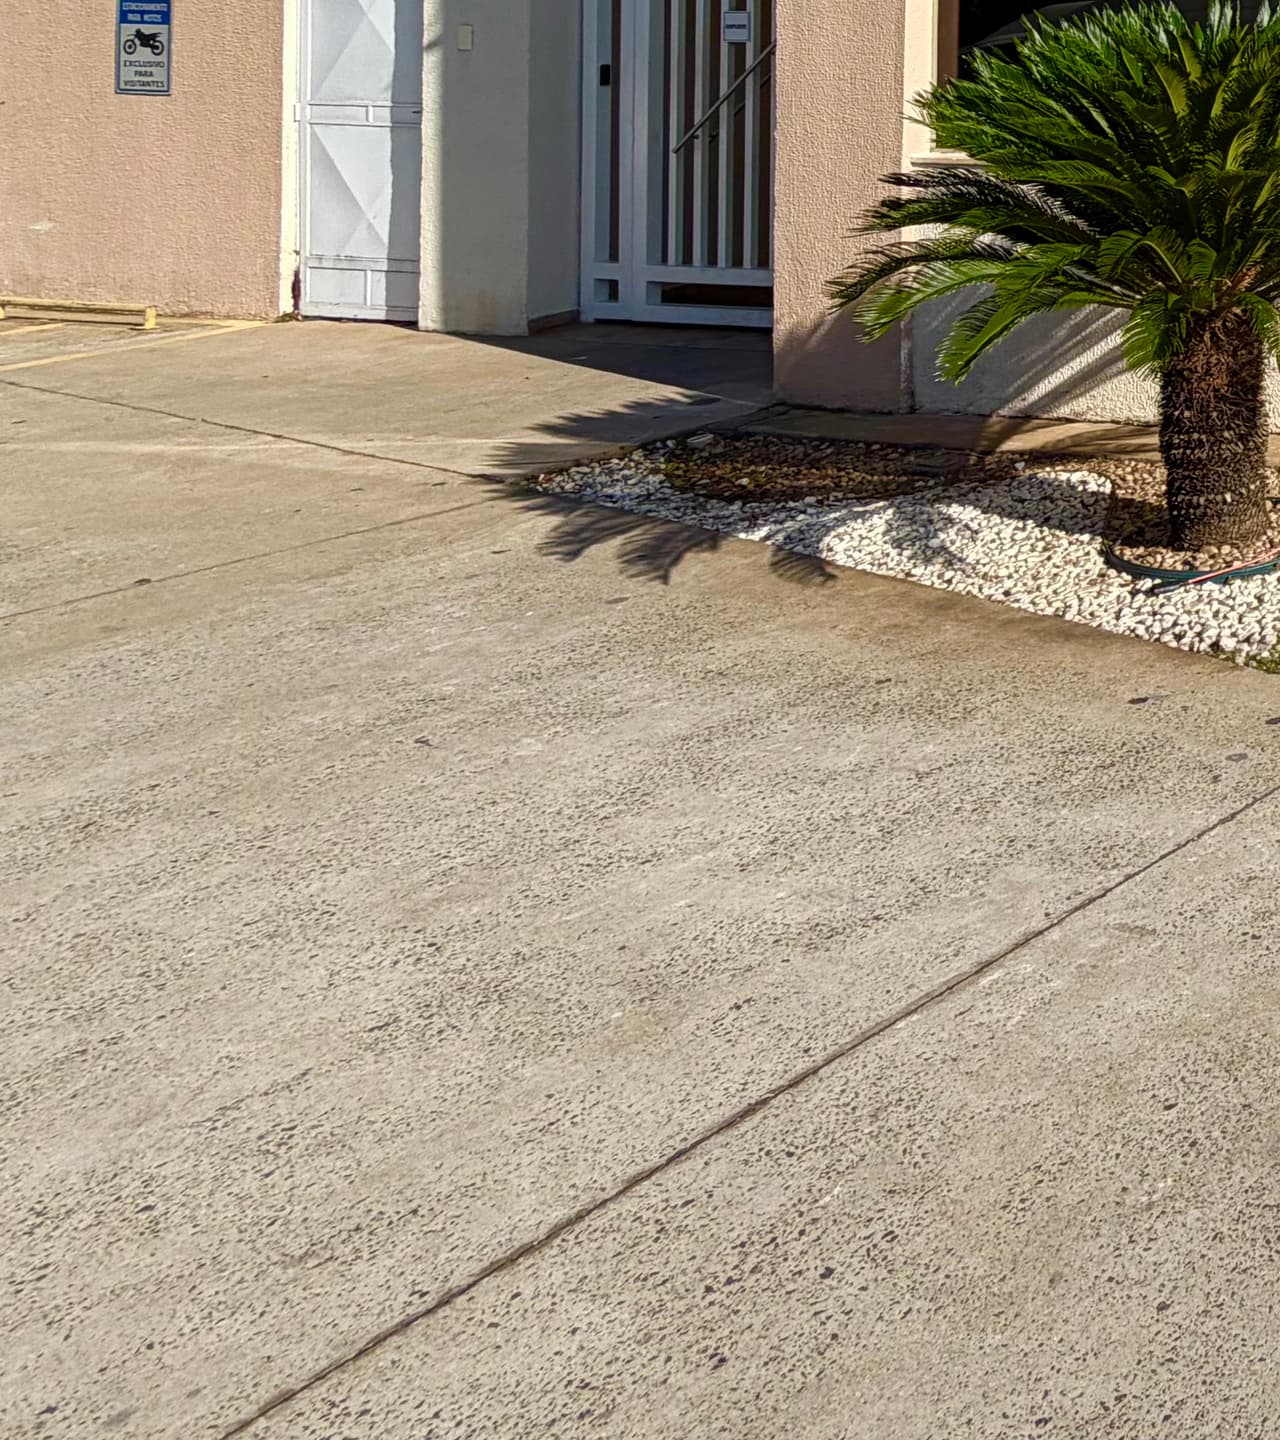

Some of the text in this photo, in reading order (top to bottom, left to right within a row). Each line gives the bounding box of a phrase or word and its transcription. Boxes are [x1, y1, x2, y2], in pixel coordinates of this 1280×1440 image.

[123, 60, 165, 68] EXCLUSIVO
[134, 70, 154, 78] PARA
[123, 80, 165, 88] VISITANTES
